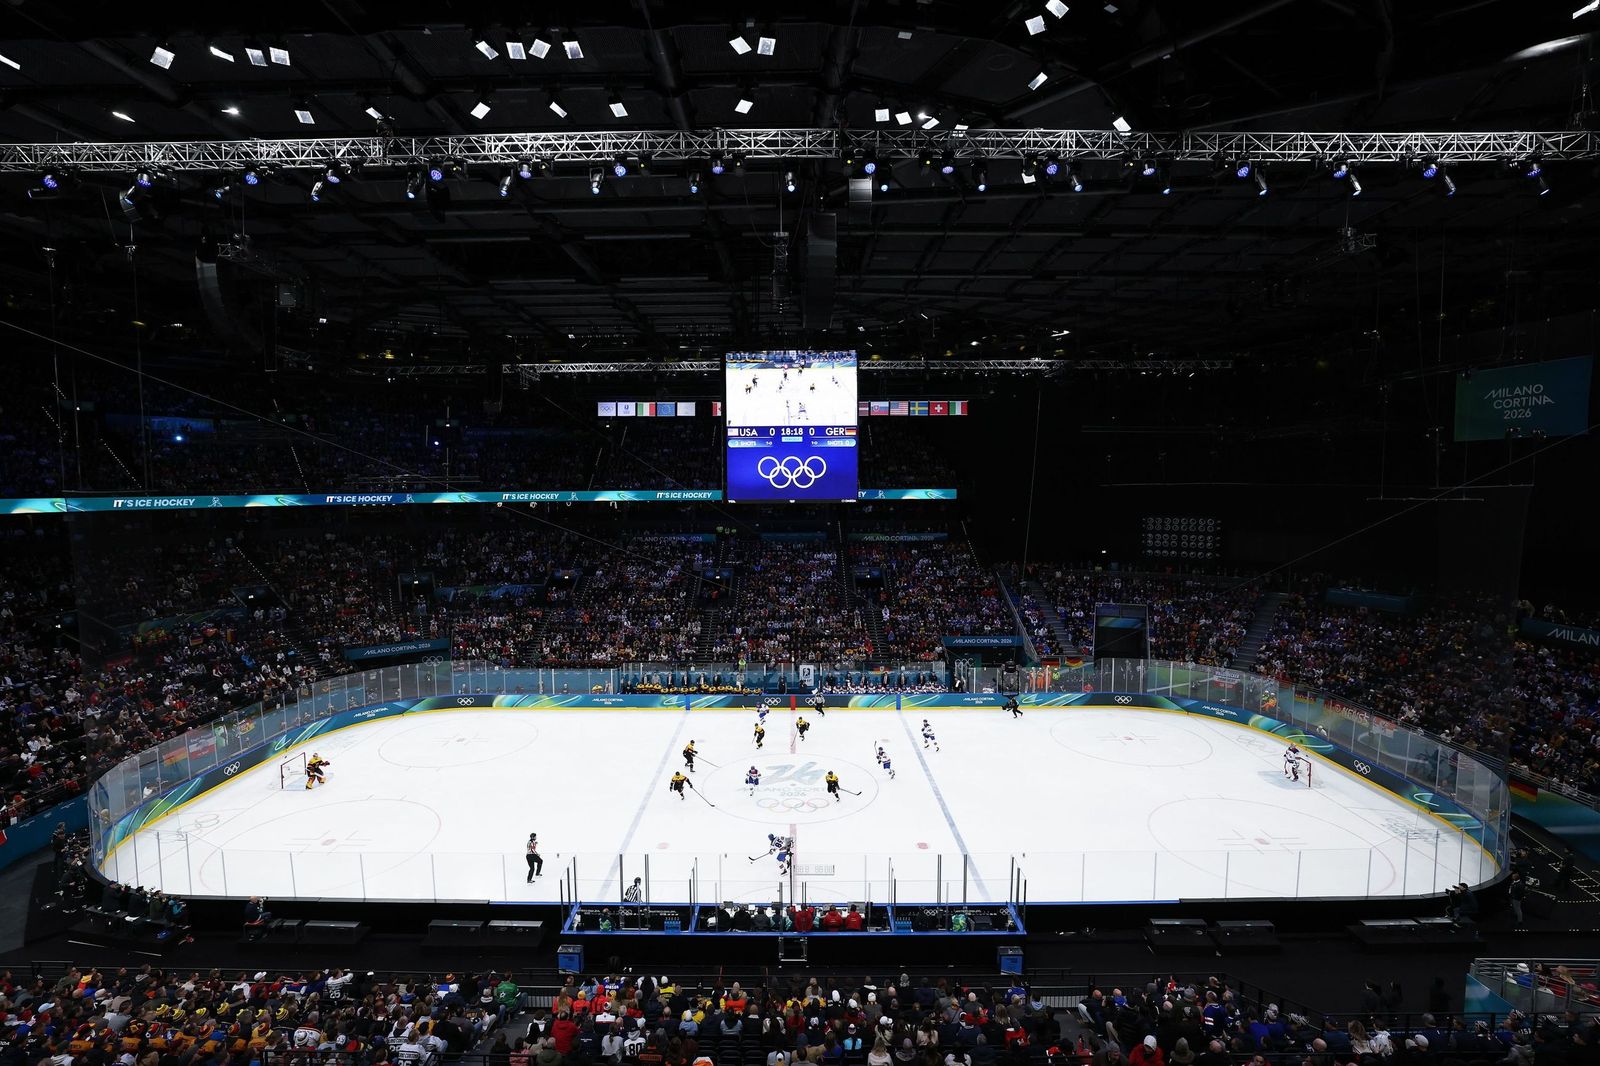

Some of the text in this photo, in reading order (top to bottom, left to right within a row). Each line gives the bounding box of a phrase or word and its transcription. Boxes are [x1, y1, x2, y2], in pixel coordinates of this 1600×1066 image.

[1484, 384, 1544, 400] MILANO
[1493, 395, 1556, 409] CORTINA
[1503, 408, 1532, 420] 2026
[739, 427, 845, 436] USA 0 18:18 0 GER
[113, 498, 196, 508] IT'S ICE HOCKEY
[326, 495, 393, 504] IT'S ICE HOCKEY
[364, 647, 391, 655] MILANO
